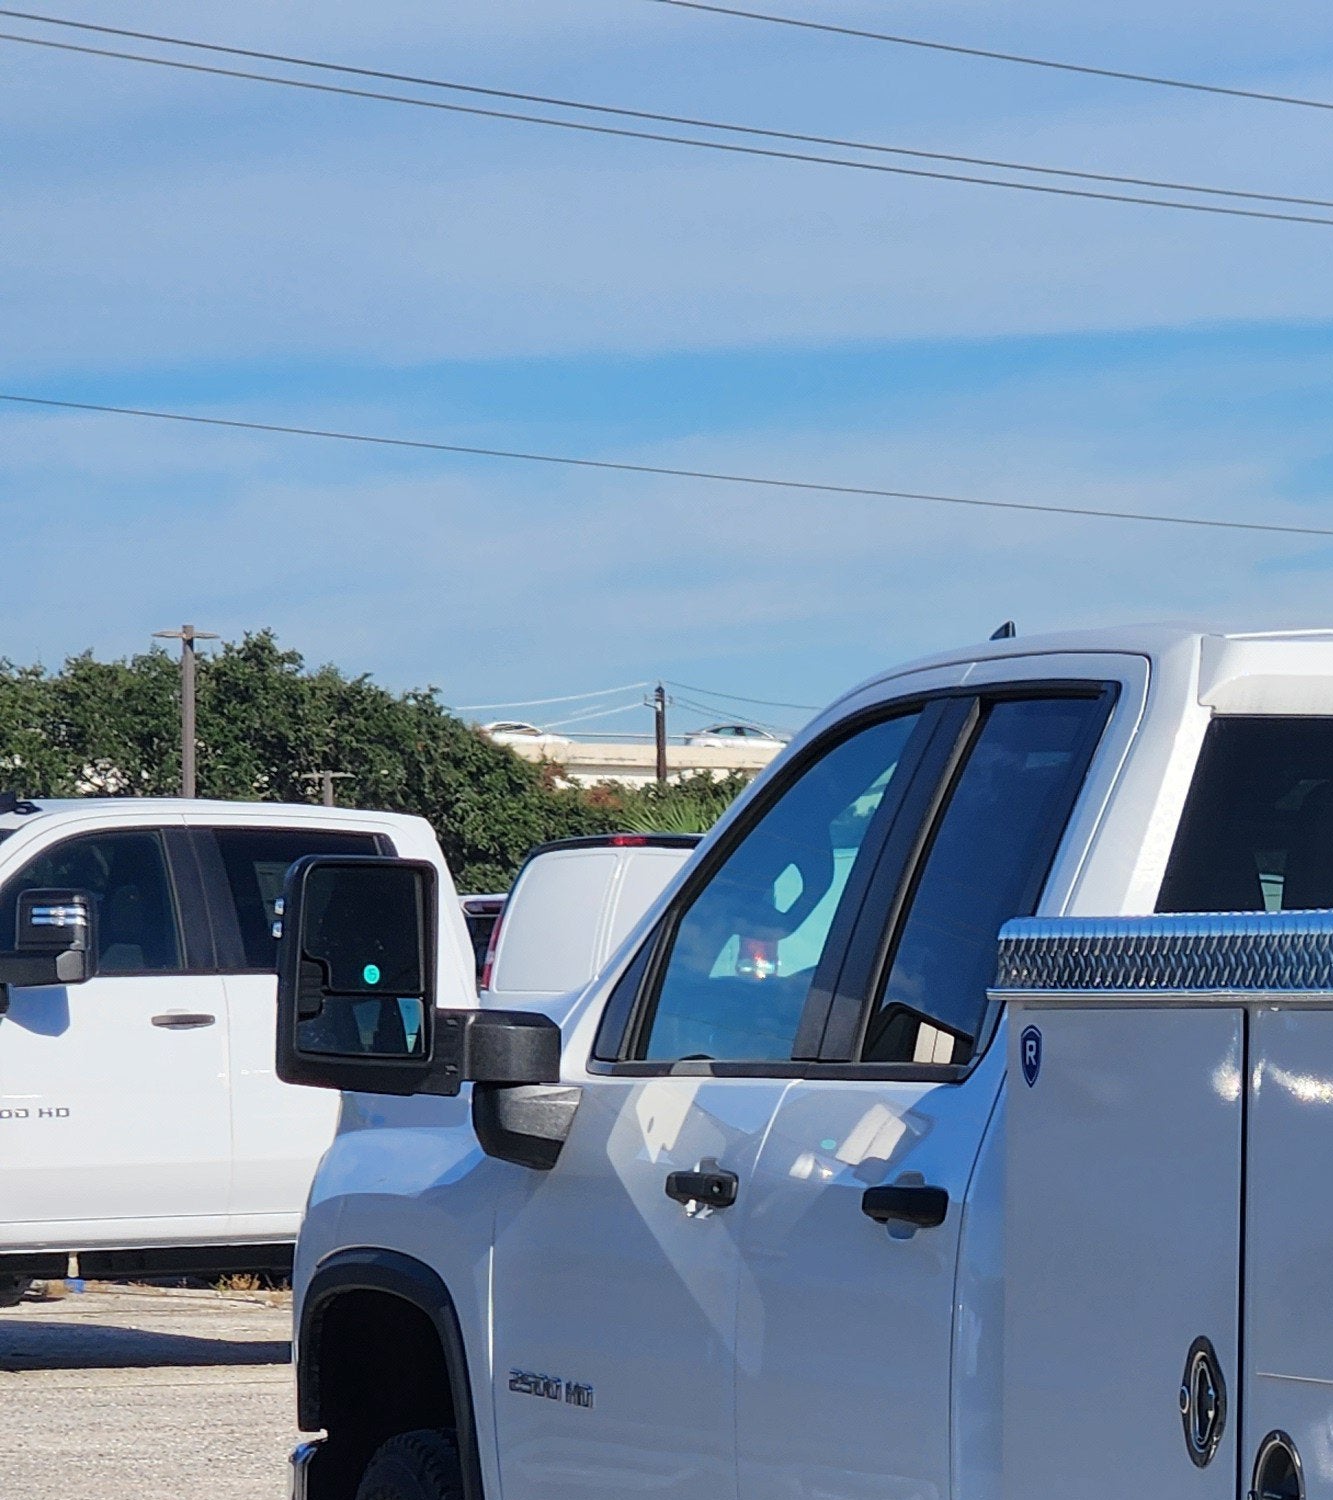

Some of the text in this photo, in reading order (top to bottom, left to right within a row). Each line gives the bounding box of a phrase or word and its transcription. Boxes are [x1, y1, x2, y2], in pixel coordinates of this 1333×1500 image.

[1026, 1040, 1037, 1066] R
[38, 1107, 70, 1118] HD
[508, 1369, 594, 1410] 2500 HD
